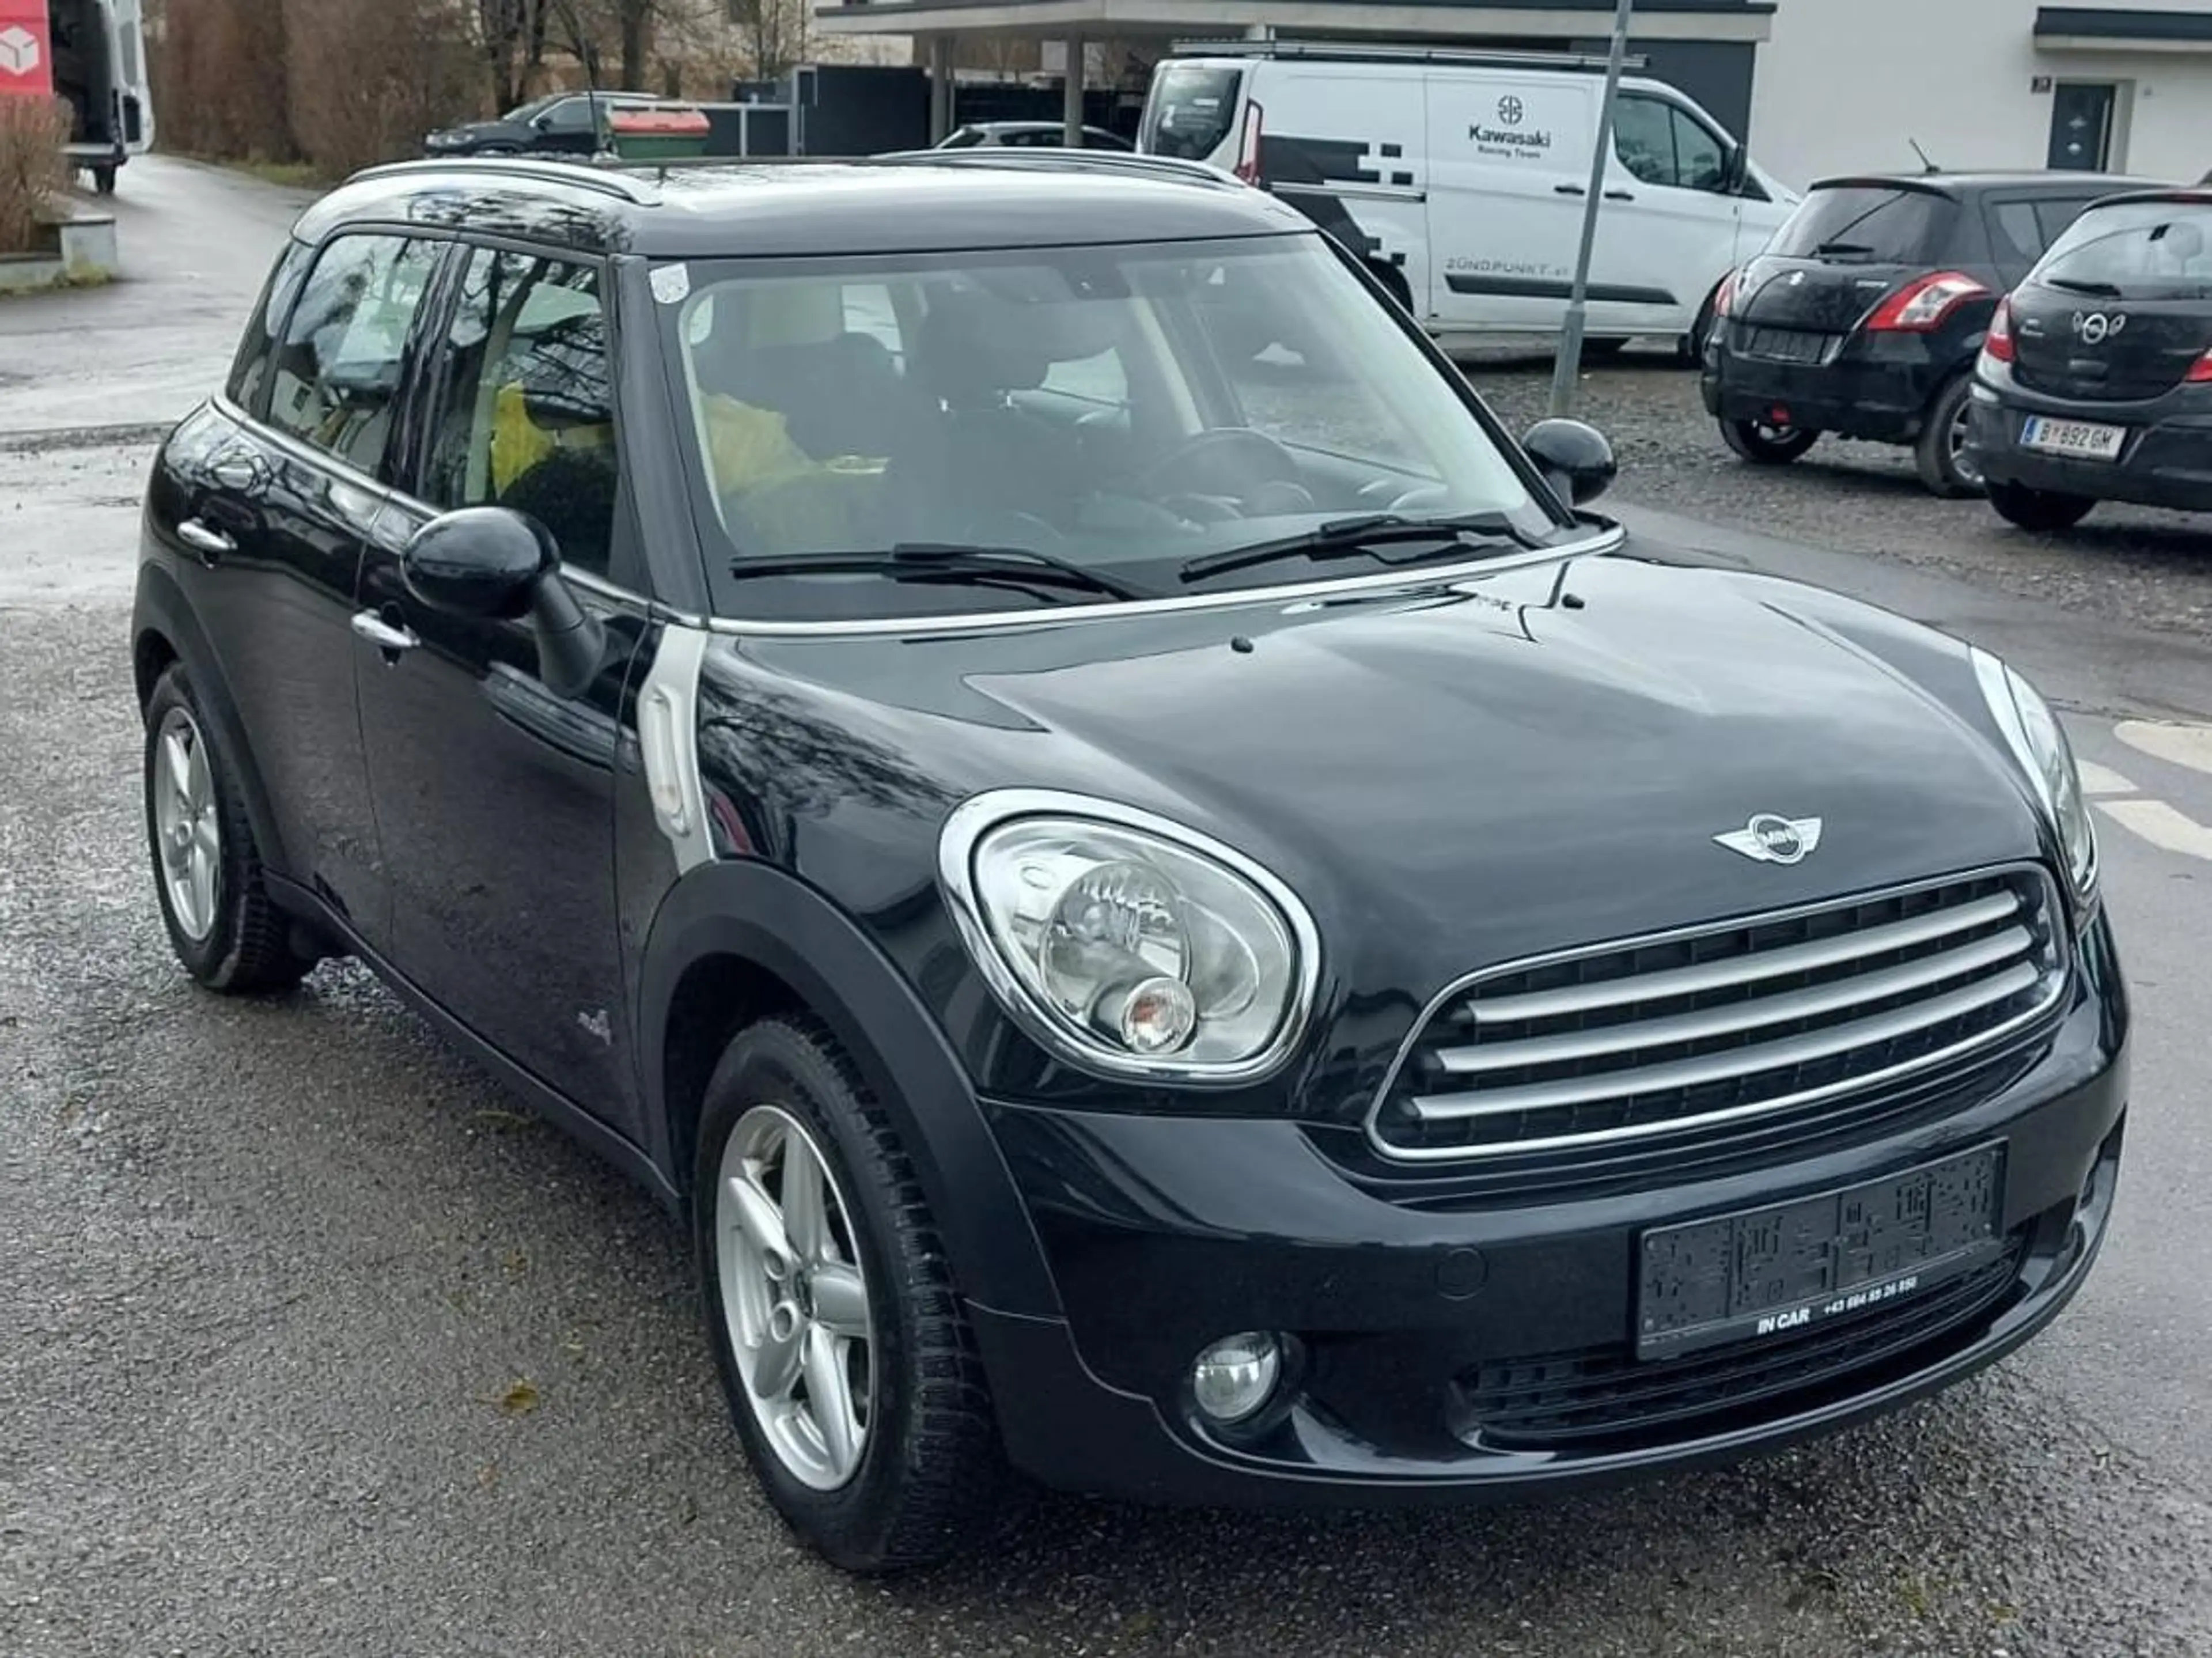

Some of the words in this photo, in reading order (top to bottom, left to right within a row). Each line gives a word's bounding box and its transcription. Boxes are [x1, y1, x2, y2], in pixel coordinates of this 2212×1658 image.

[1469, 124, 1551, 149] Kawasaki
[1757, 1316, 1775, 1334] IN
[1777, 1307, 1810, 1329] CAR
